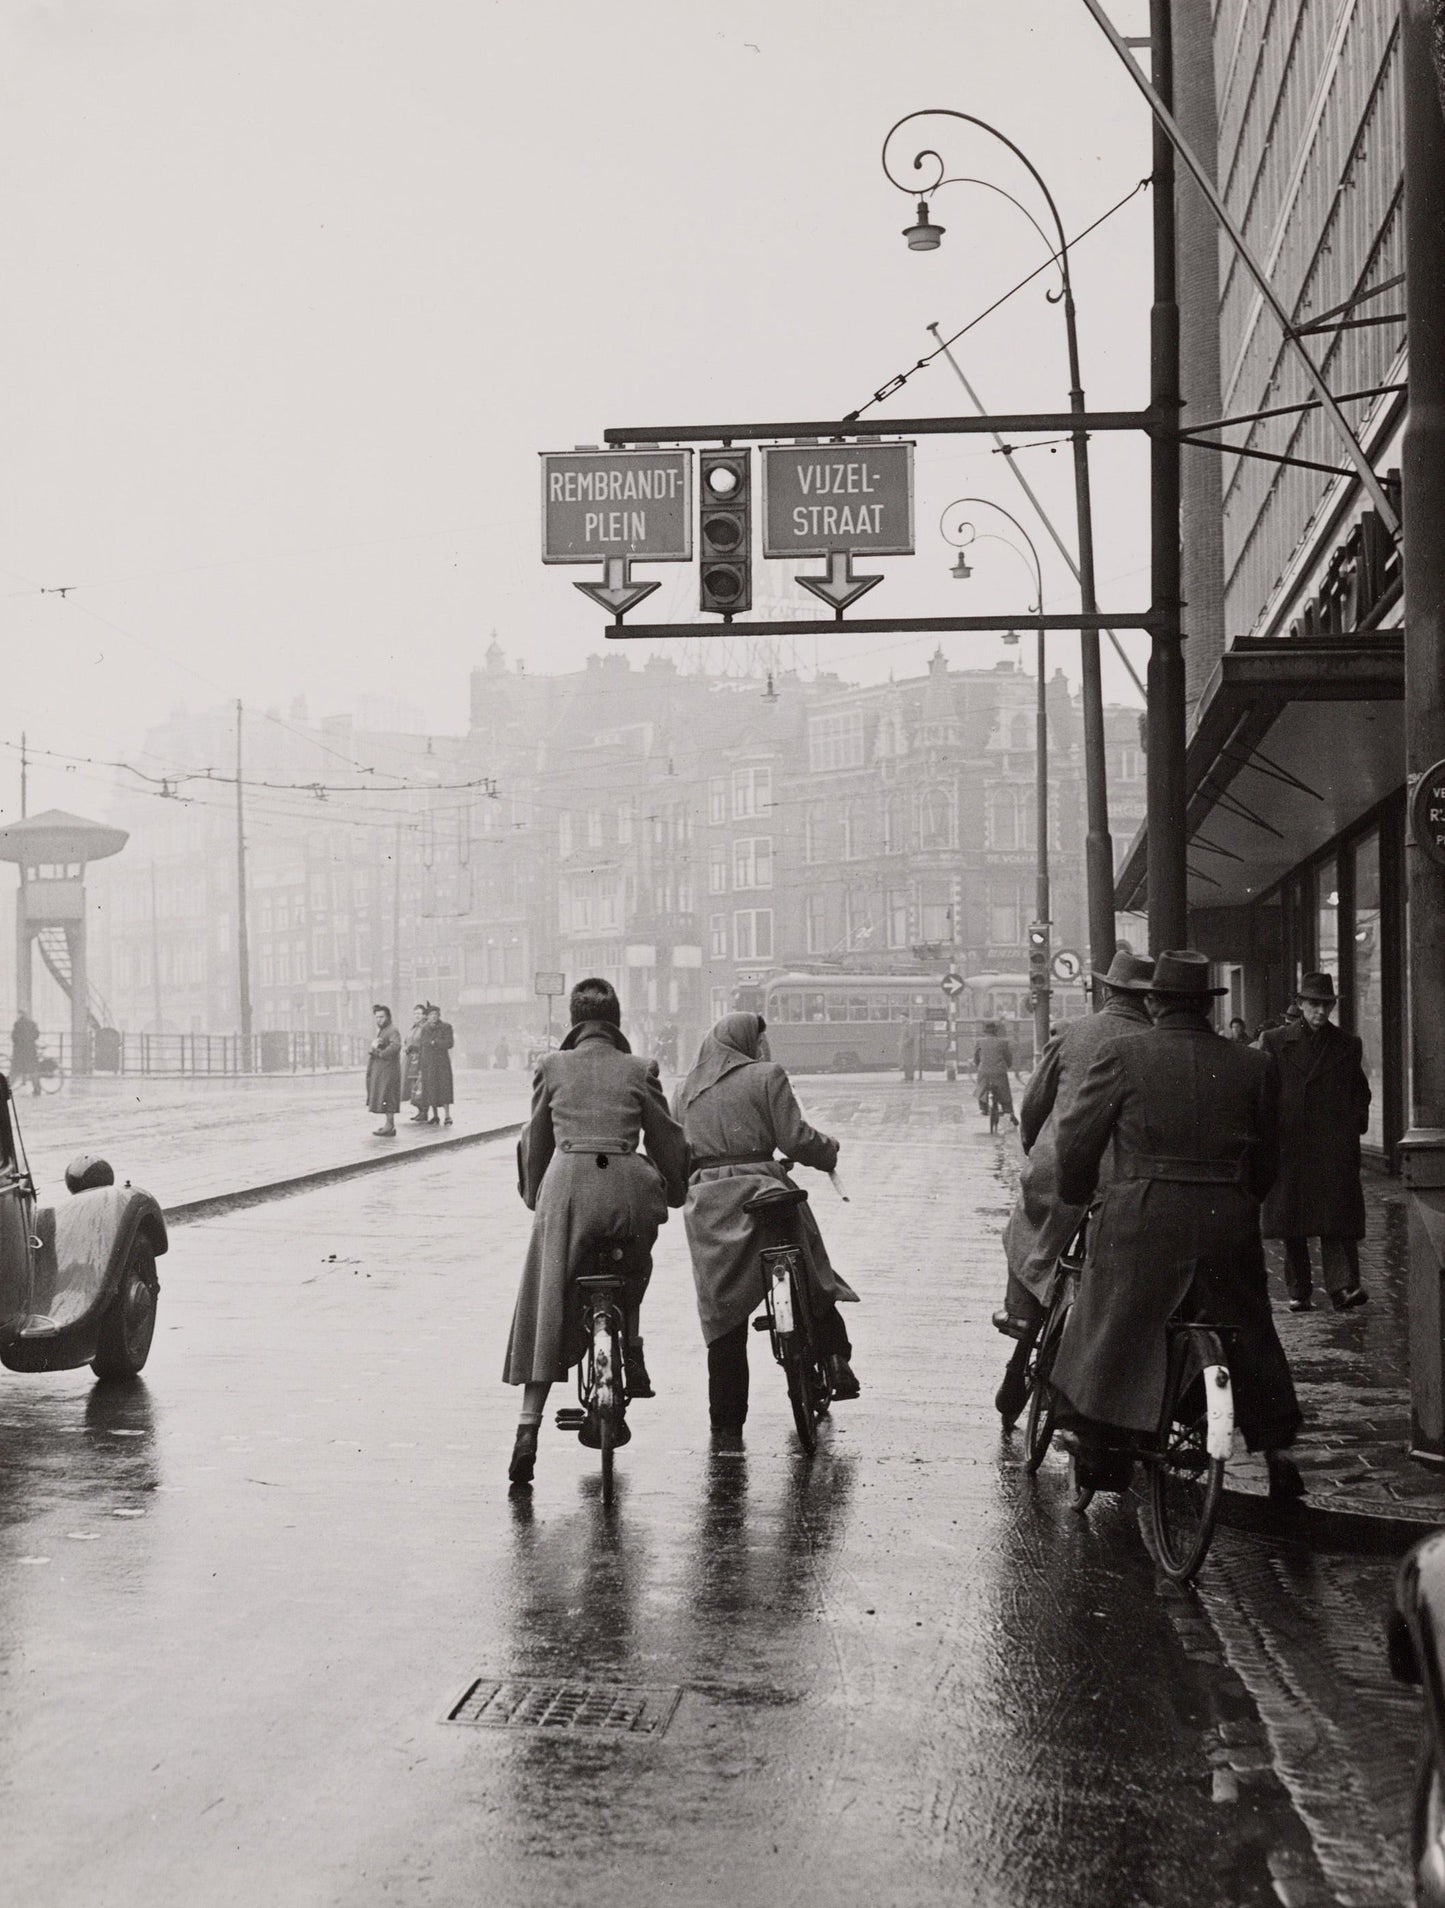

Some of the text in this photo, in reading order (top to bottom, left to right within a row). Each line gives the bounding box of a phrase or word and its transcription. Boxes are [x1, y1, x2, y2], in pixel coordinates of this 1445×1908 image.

[550, 469, 683, 502] REMBRANDT-
[585, 511, 646, 542] PLEIN
[793, 504, 884, 535] STRAAT
